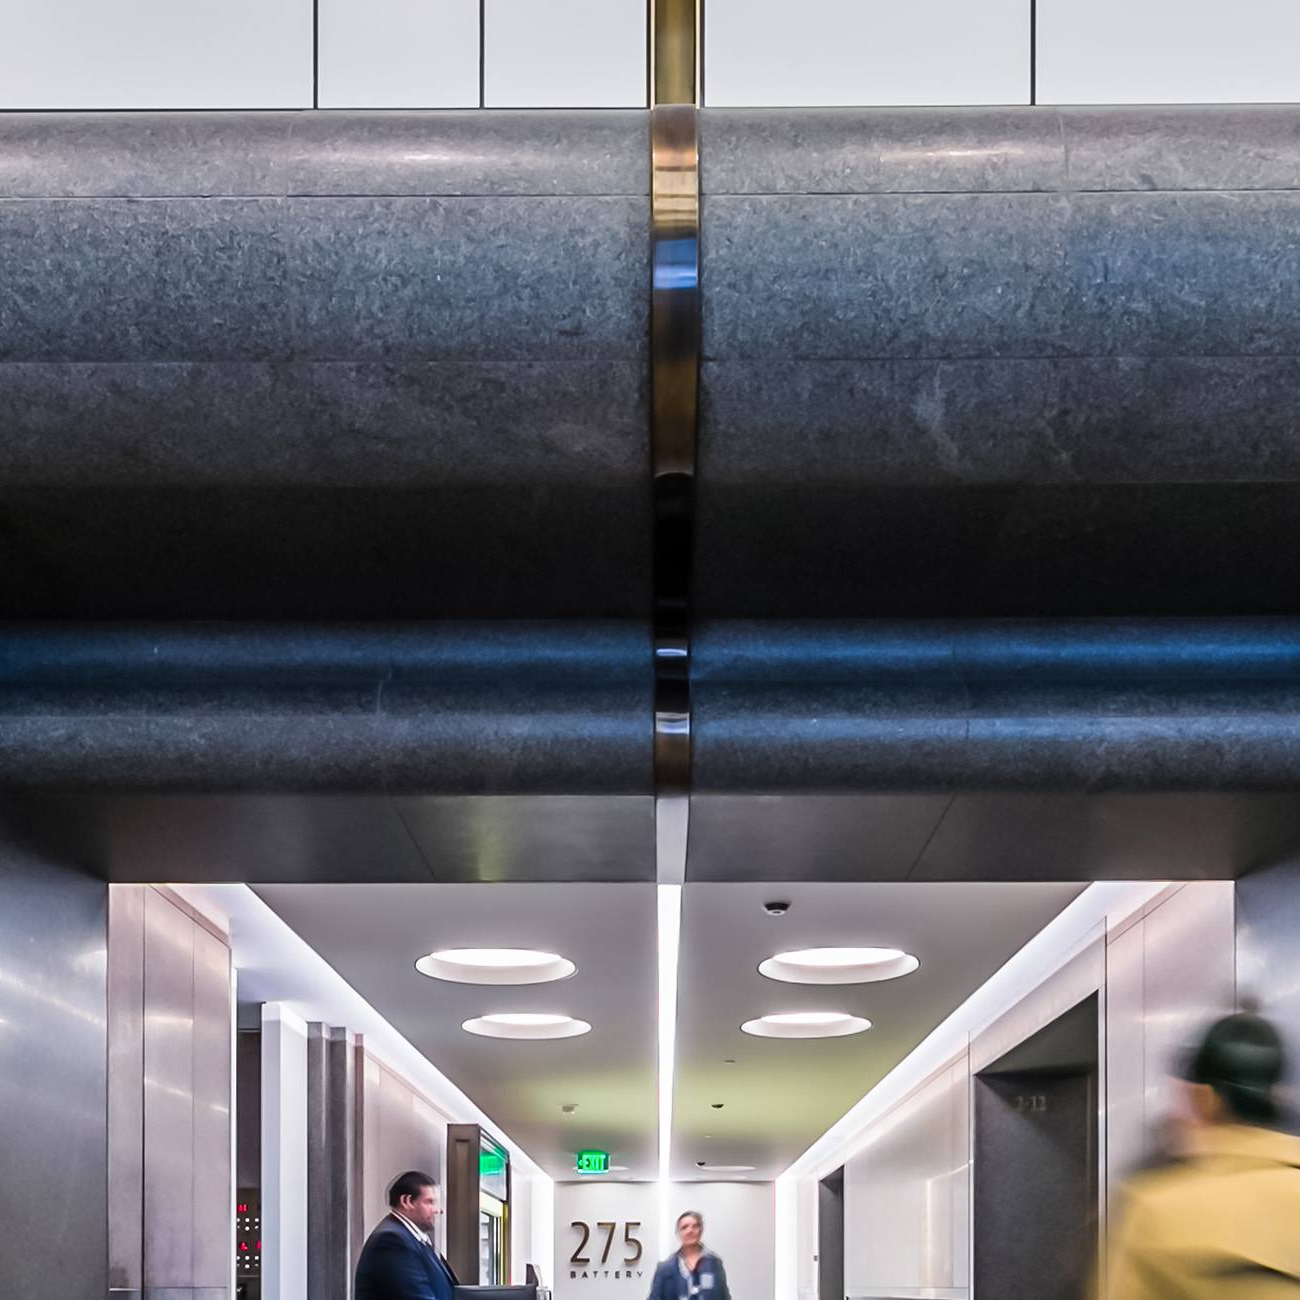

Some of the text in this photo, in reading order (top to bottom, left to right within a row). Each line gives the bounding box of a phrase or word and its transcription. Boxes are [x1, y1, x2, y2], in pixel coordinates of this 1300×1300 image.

[582, 1154, 606, 1170] EXIT
[570, 1221, 643, 1264] 275
[570, 1271, 643, 1279] BATTERY
